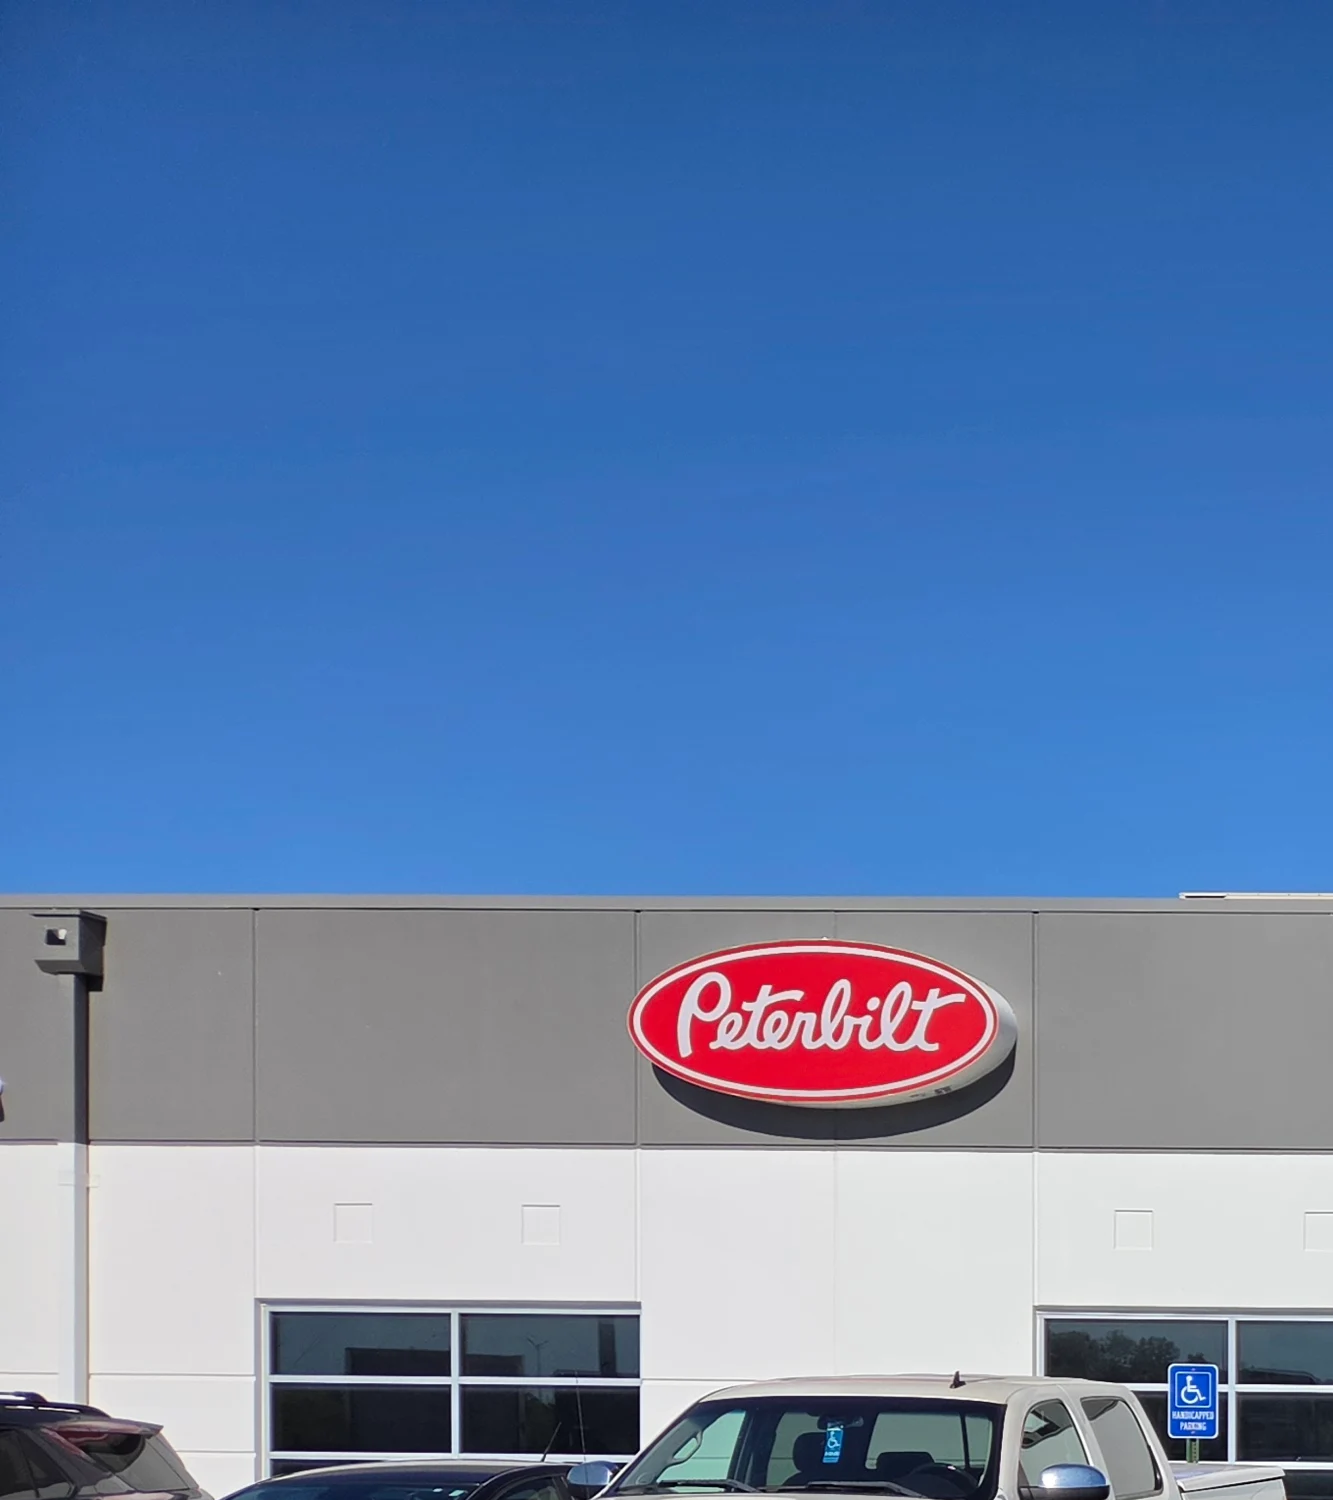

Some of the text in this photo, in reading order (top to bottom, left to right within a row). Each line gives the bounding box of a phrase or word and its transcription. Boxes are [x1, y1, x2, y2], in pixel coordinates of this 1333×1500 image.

[676, 971, 967, 1059] Peterbilt
[1172, 1411, 1214, 1420] HANDICAPPED
[1180, 1422, 1207, 1431] PARKING
